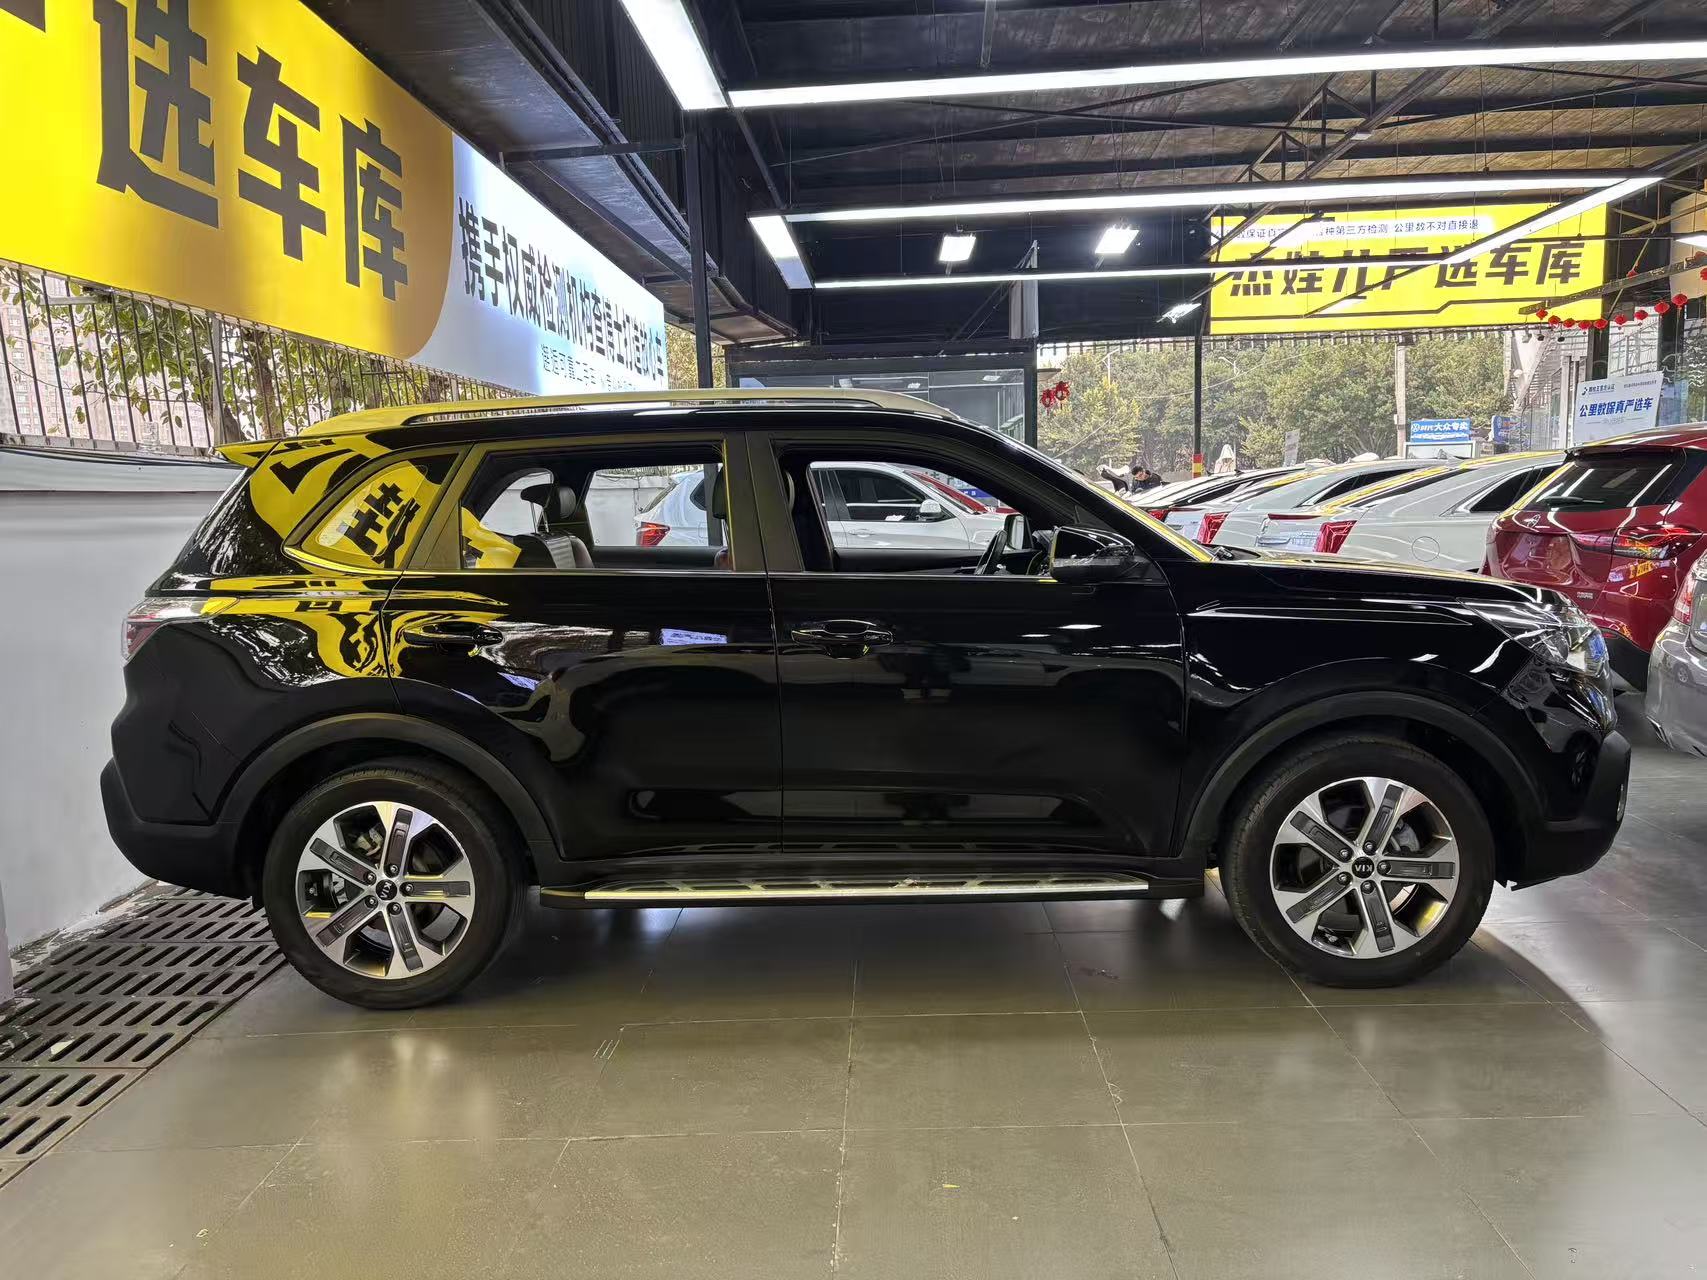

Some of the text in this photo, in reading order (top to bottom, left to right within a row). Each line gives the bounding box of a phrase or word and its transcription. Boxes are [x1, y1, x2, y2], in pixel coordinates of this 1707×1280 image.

[0, 0, 409, 302] 选车库
[1394, 218, 1480, 233] 公里数不对直接退
[1579, 396, 1654, 418] 公里数保真严选车
[1355, 864, 1373, 872] KIA
[380, 882, 392, 898] KIA
